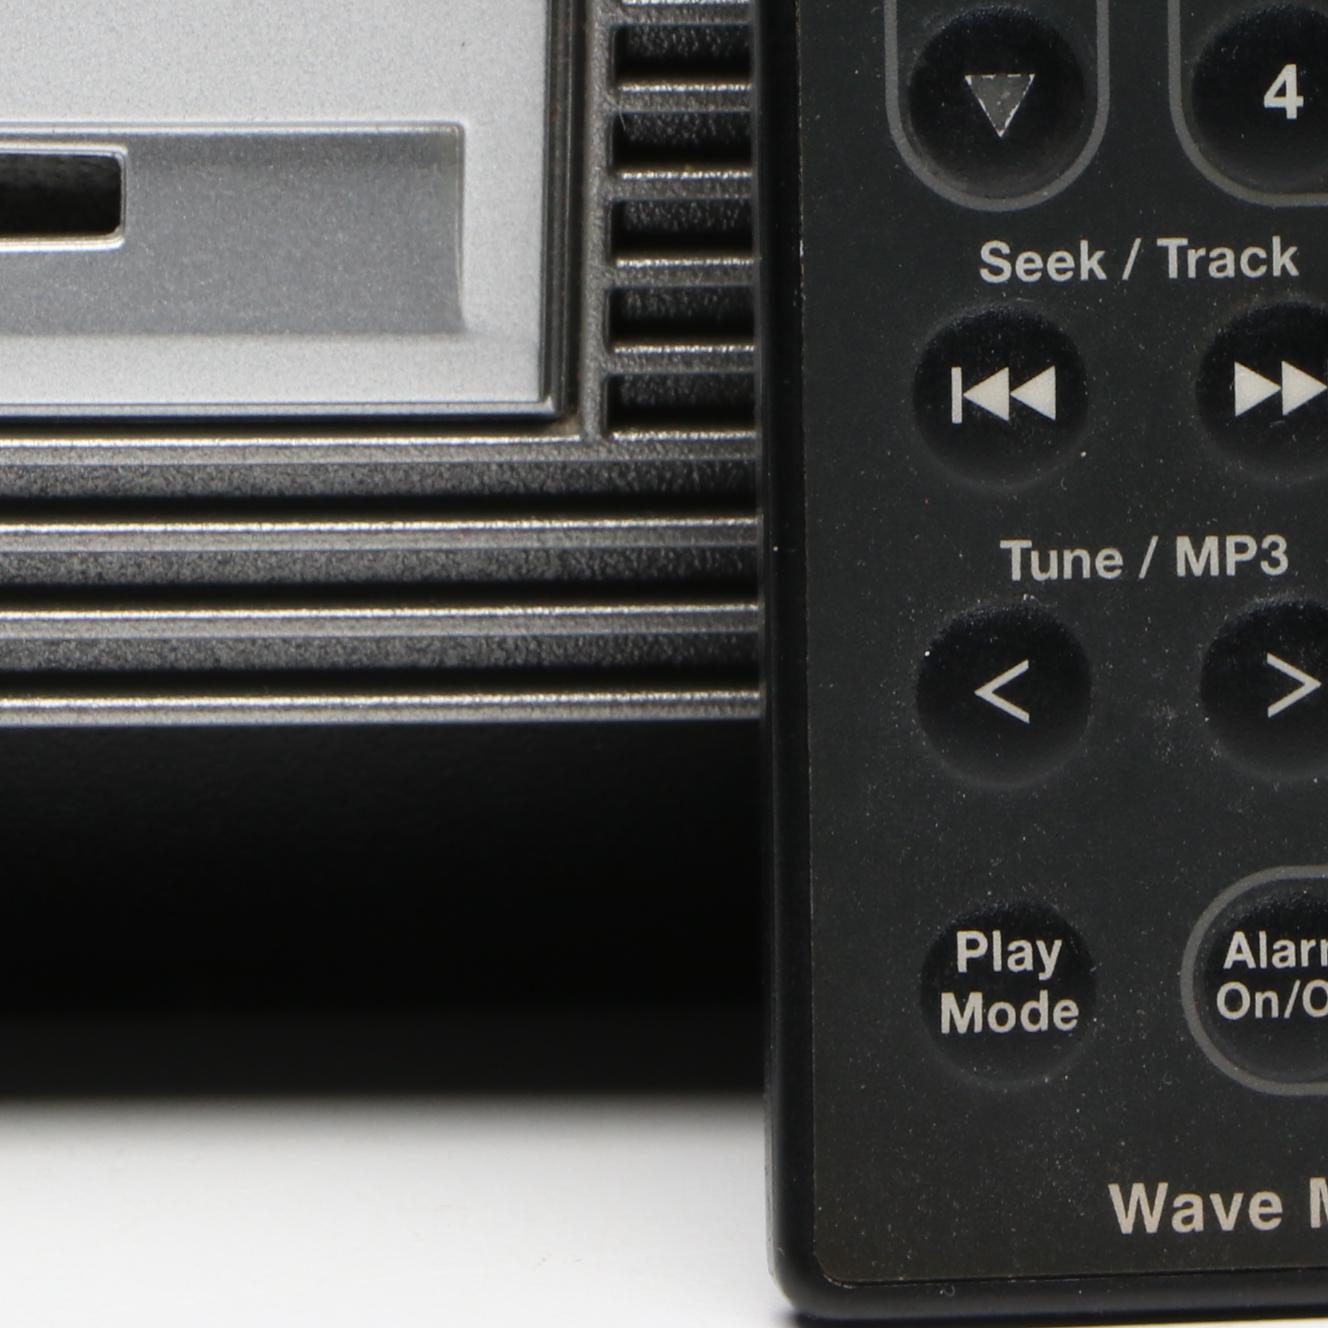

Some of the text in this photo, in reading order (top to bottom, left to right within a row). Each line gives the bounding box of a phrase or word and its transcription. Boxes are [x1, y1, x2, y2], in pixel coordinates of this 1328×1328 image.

[1263, 63, 1304, 120] 4
[979, 239, 1107, 284] Seek
[1156, 235, 1299, 279] Track
[999, 539, 1124, 582] Tune
[1176, 534, 1289, 577] MP3
[956, 930, 1063, 981] Play
[940, 989, 1079, 1034] Mode
[1107, 1182, 1283, 1234] Wave
